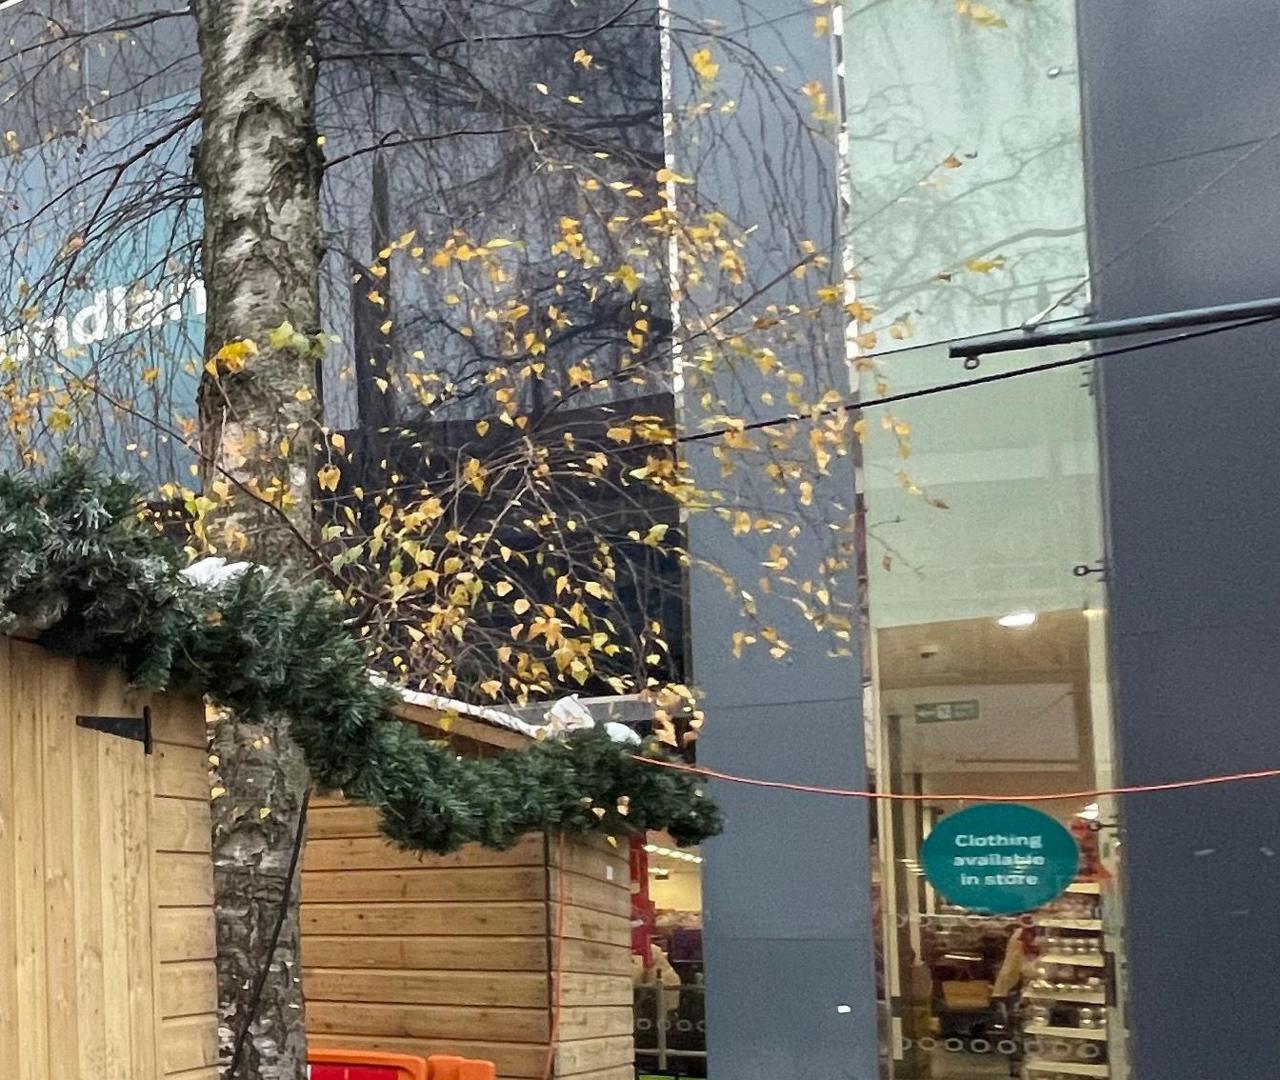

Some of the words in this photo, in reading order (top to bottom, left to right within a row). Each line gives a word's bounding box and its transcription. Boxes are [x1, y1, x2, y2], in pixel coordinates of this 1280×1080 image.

[954, 834, 1043, 849] Clothing
[952, 853, 1046, 867] available
[959, 873, 980, 886] in
[983, 874, 1039, 886] store
